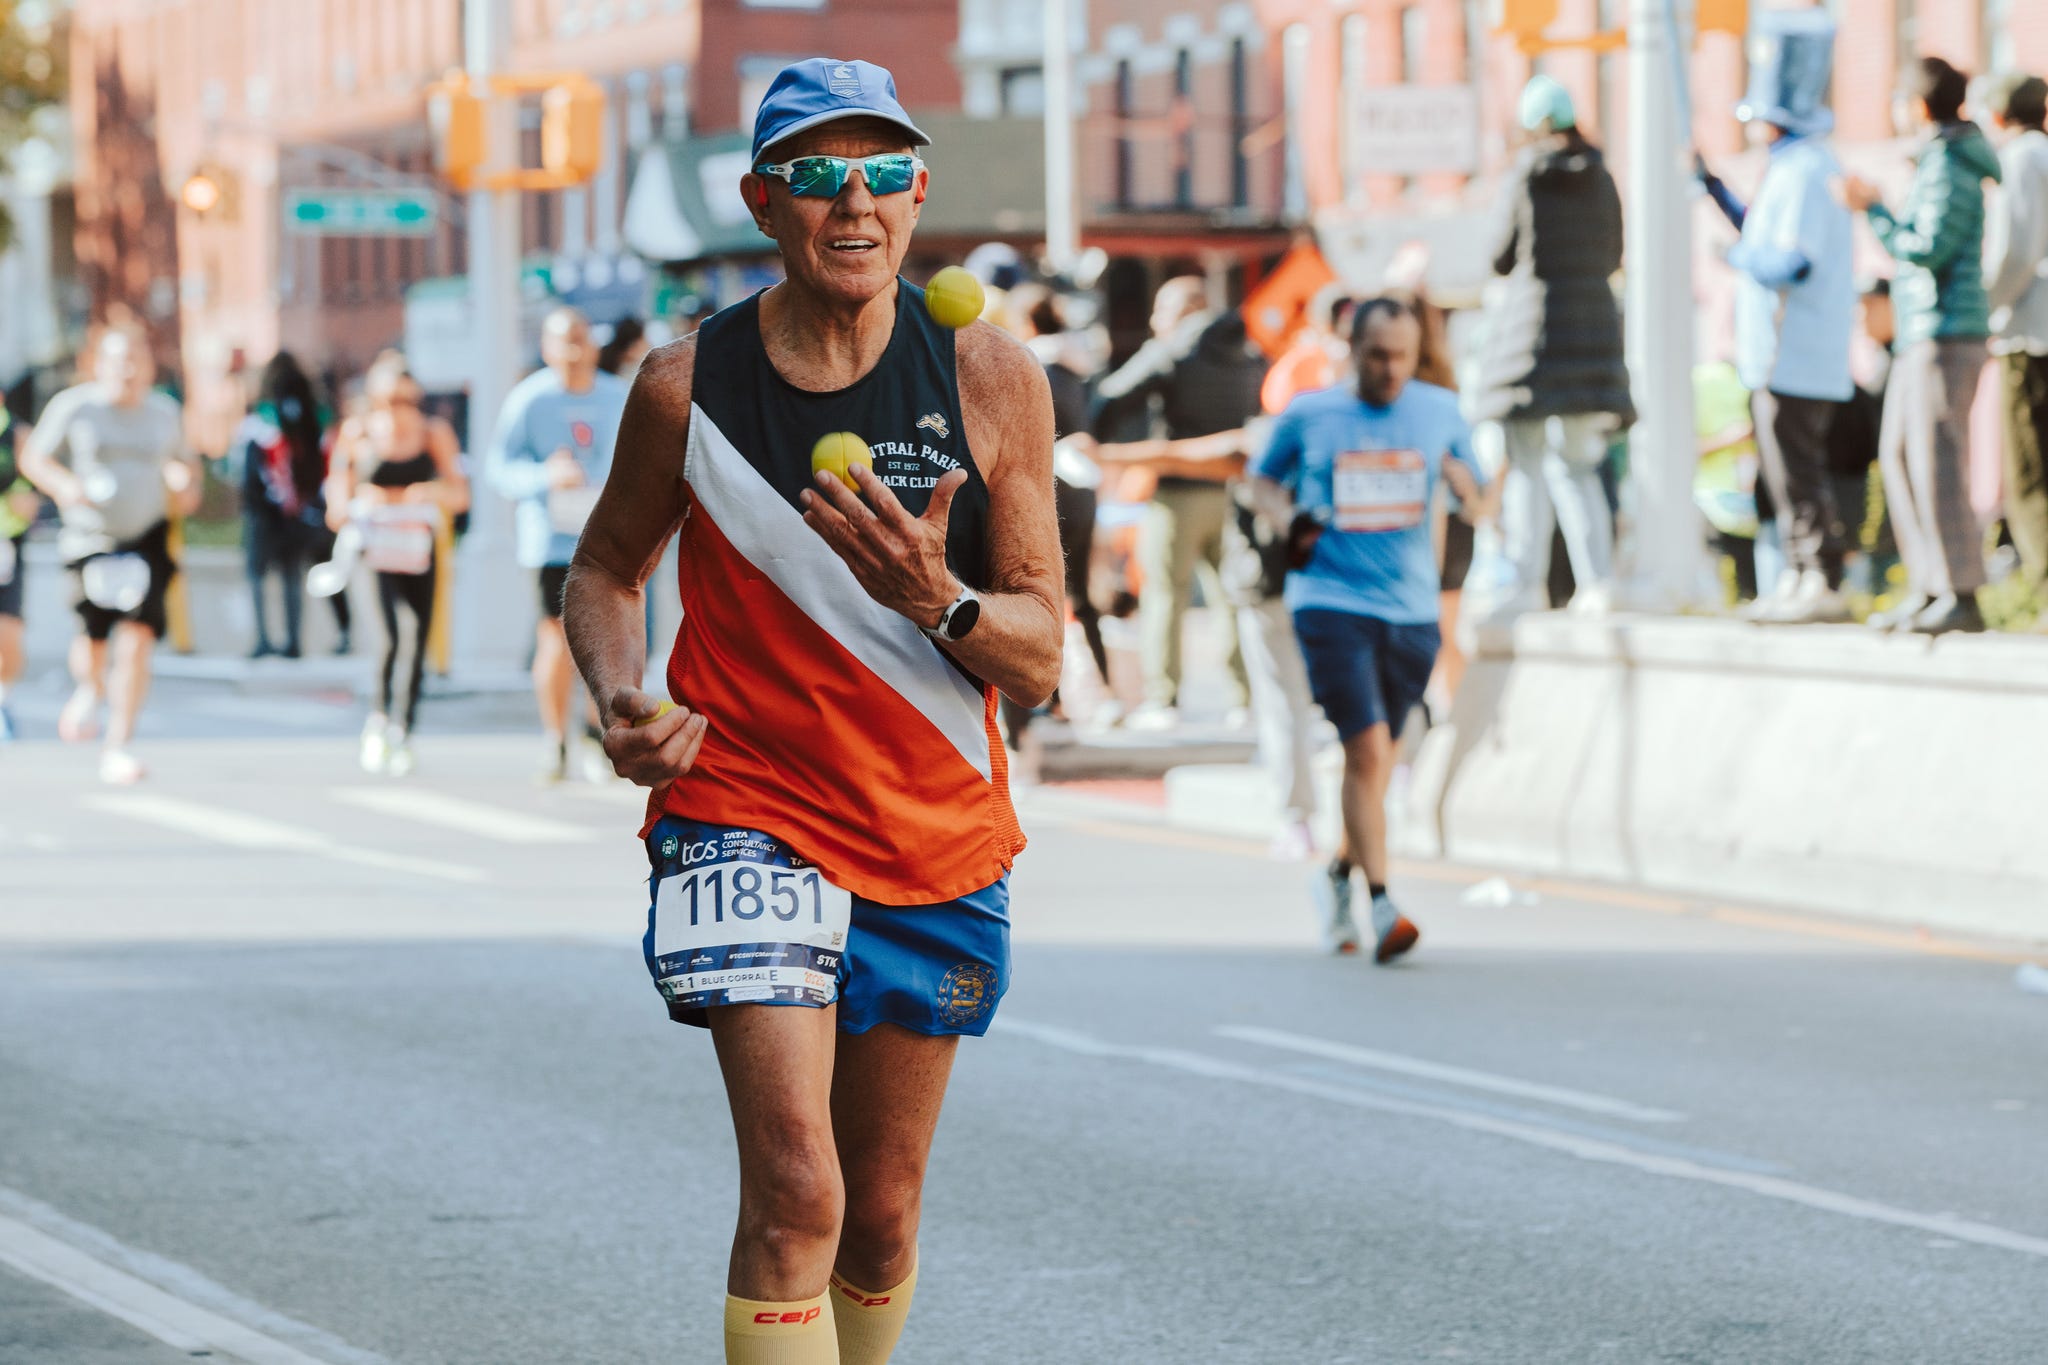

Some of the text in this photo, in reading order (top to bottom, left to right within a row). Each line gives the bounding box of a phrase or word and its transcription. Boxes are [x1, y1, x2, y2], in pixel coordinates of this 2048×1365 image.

[868, 441, 961, 471] TRAL PARK
[888, 461, 920, 470] EST 1972
[876, 475, 907, 487] ACK
[723, 831, 748, 840] TATA
[721, 839, 778, 853] CONSULTANCY
[682, 840, 718, 866] tcs
[721, 848, 757, 858] SERVICES
[681, 866, 822, 926] 11851
[816, 955, 838, 968] STK
[671, 970, 778, 989] VE 1 BLUE CORRAL E
[794, 987, 803, 998] B
[754, 1305, 821, 1325] cep
